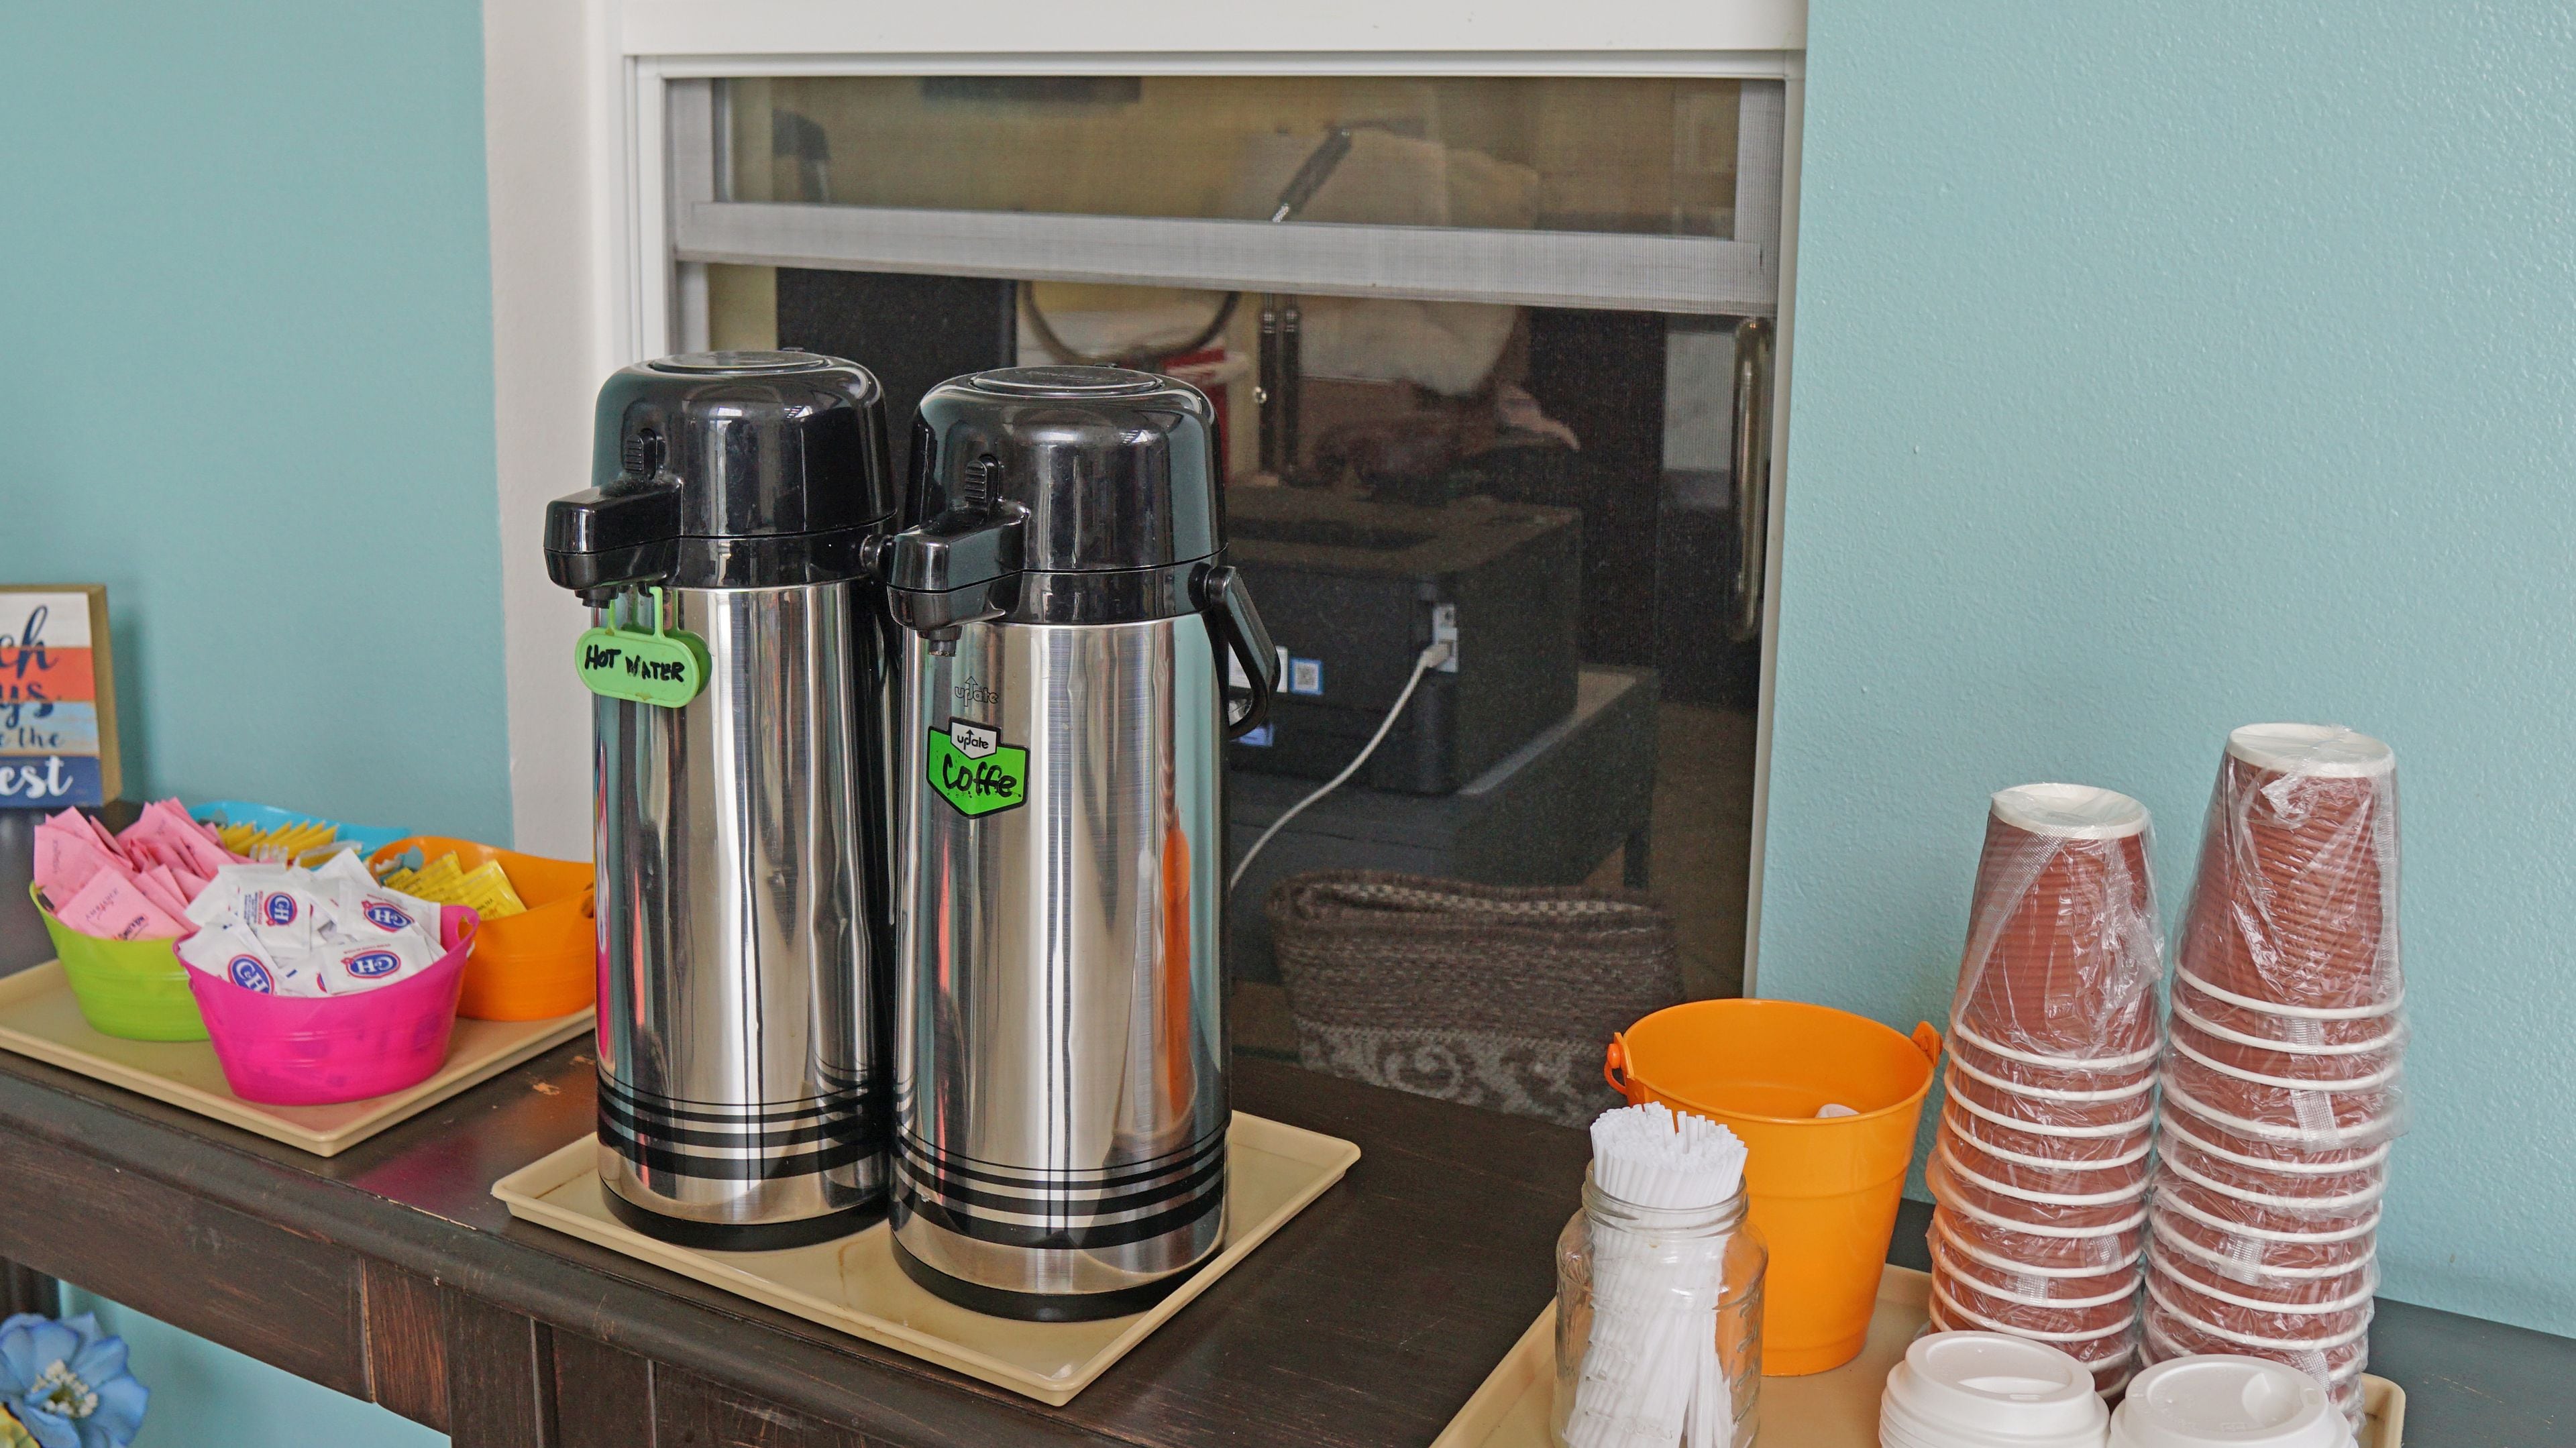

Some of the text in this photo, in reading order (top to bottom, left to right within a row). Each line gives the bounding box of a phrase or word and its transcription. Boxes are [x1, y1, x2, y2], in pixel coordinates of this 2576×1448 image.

[584, 645, 685, 682] HOT WATER
[955, 676, 999, 707] update
[19, 726, 64, 747] the
[957, 730, 989, 750] update
[943, 753, 1017, 797] Coffe
